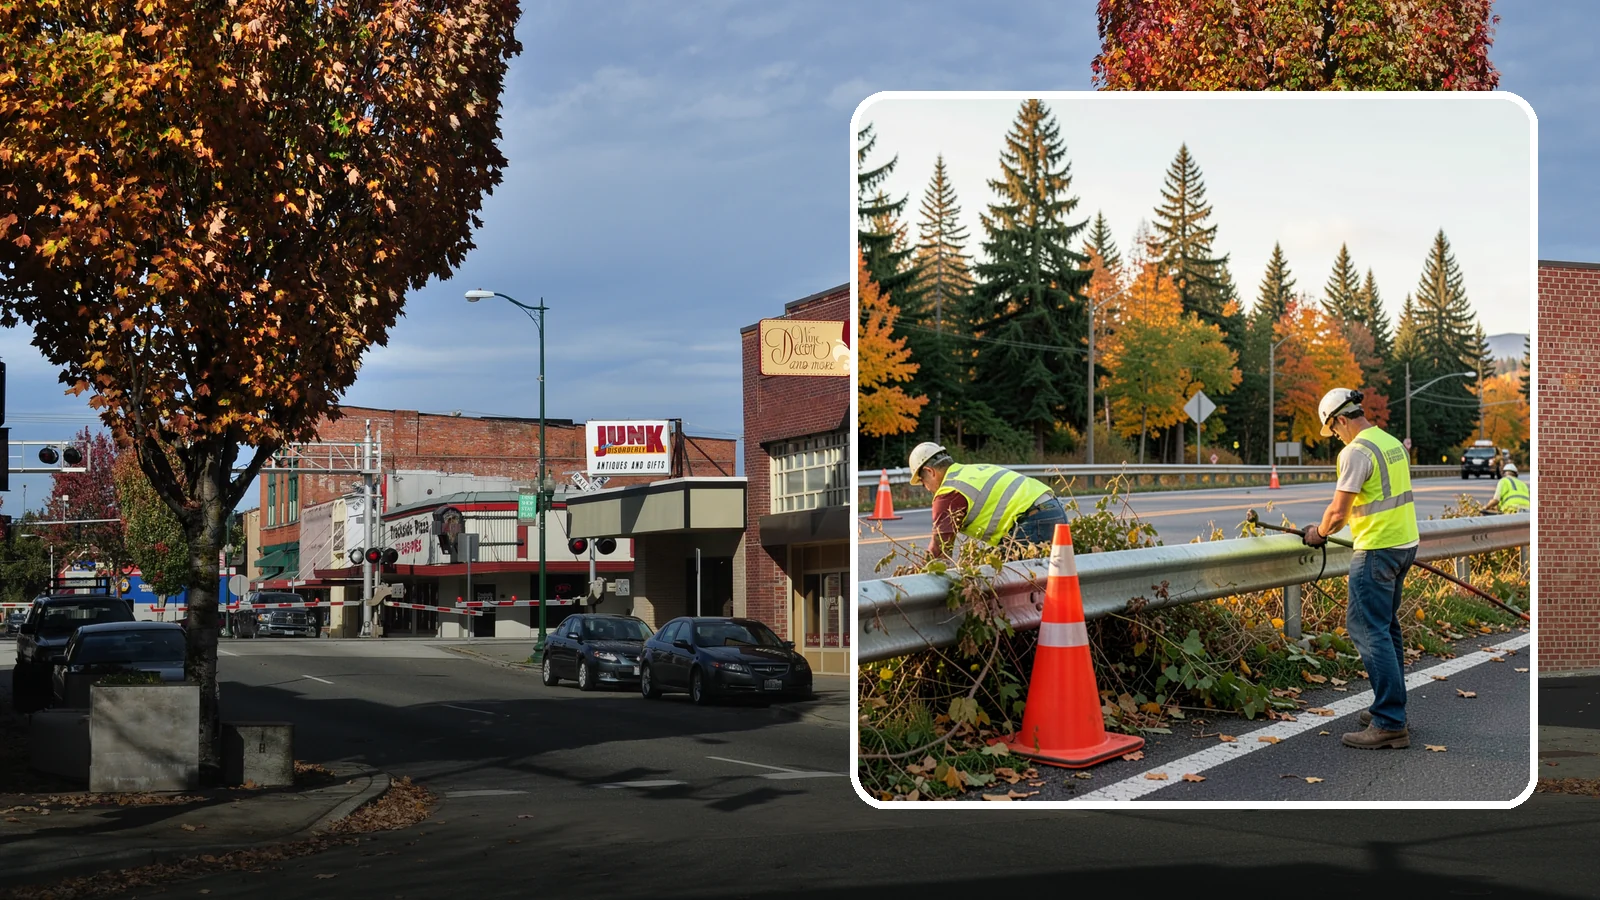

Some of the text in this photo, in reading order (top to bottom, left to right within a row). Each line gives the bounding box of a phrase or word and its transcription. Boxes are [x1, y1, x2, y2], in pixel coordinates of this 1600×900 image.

[596, 425, 665, 457] JUNK
[608, 446, 646, 454] DISORDERLY
[597, 460, 665, 470] ANTIQUES AND GIFTS
[390, 520, 429, 539] Trackside Pizza
